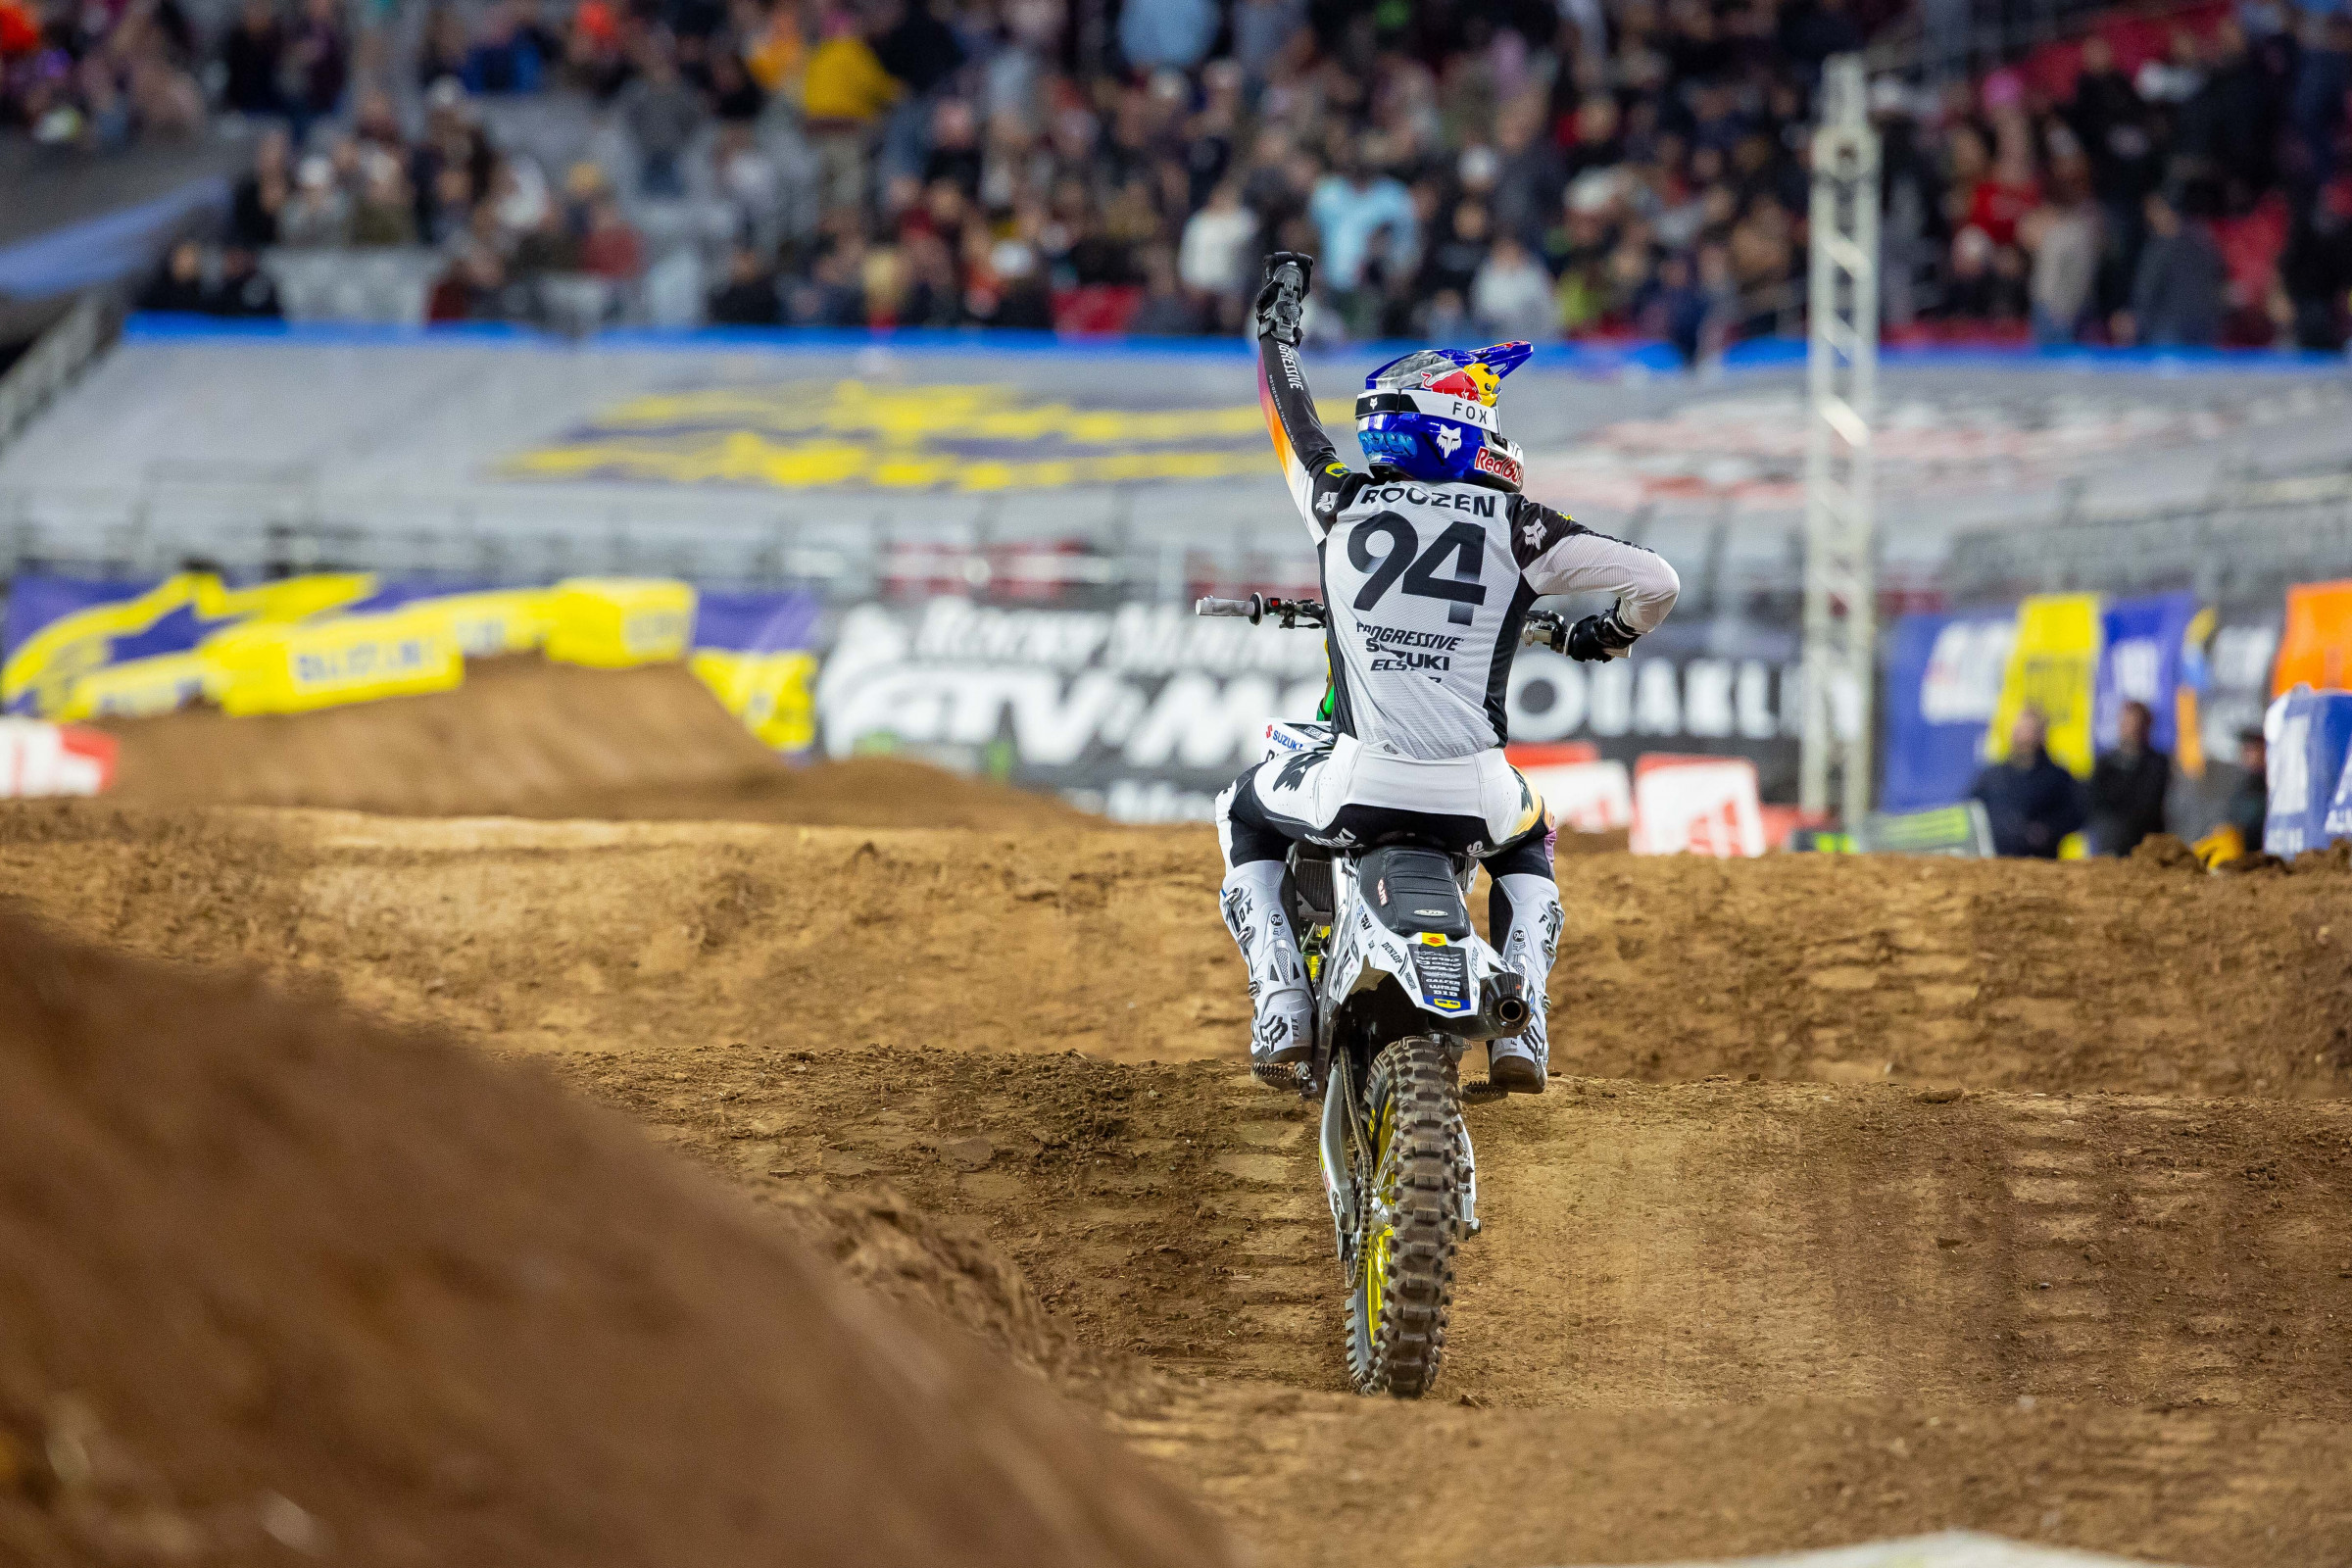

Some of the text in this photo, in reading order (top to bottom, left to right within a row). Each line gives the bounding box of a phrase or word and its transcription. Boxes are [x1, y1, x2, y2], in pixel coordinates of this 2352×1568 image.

[1277, 341, 1304, 391] GRESSIVE
[1452, 401, 1488, 424] FOX
[1360, 487, 1495, 518] ROCZEN
[1348, 510, 1488, 627] 94
[1356, 621, 1461, 651] PROGRESSIVE
[1382, 942, 1403, 964] DUNLOP
